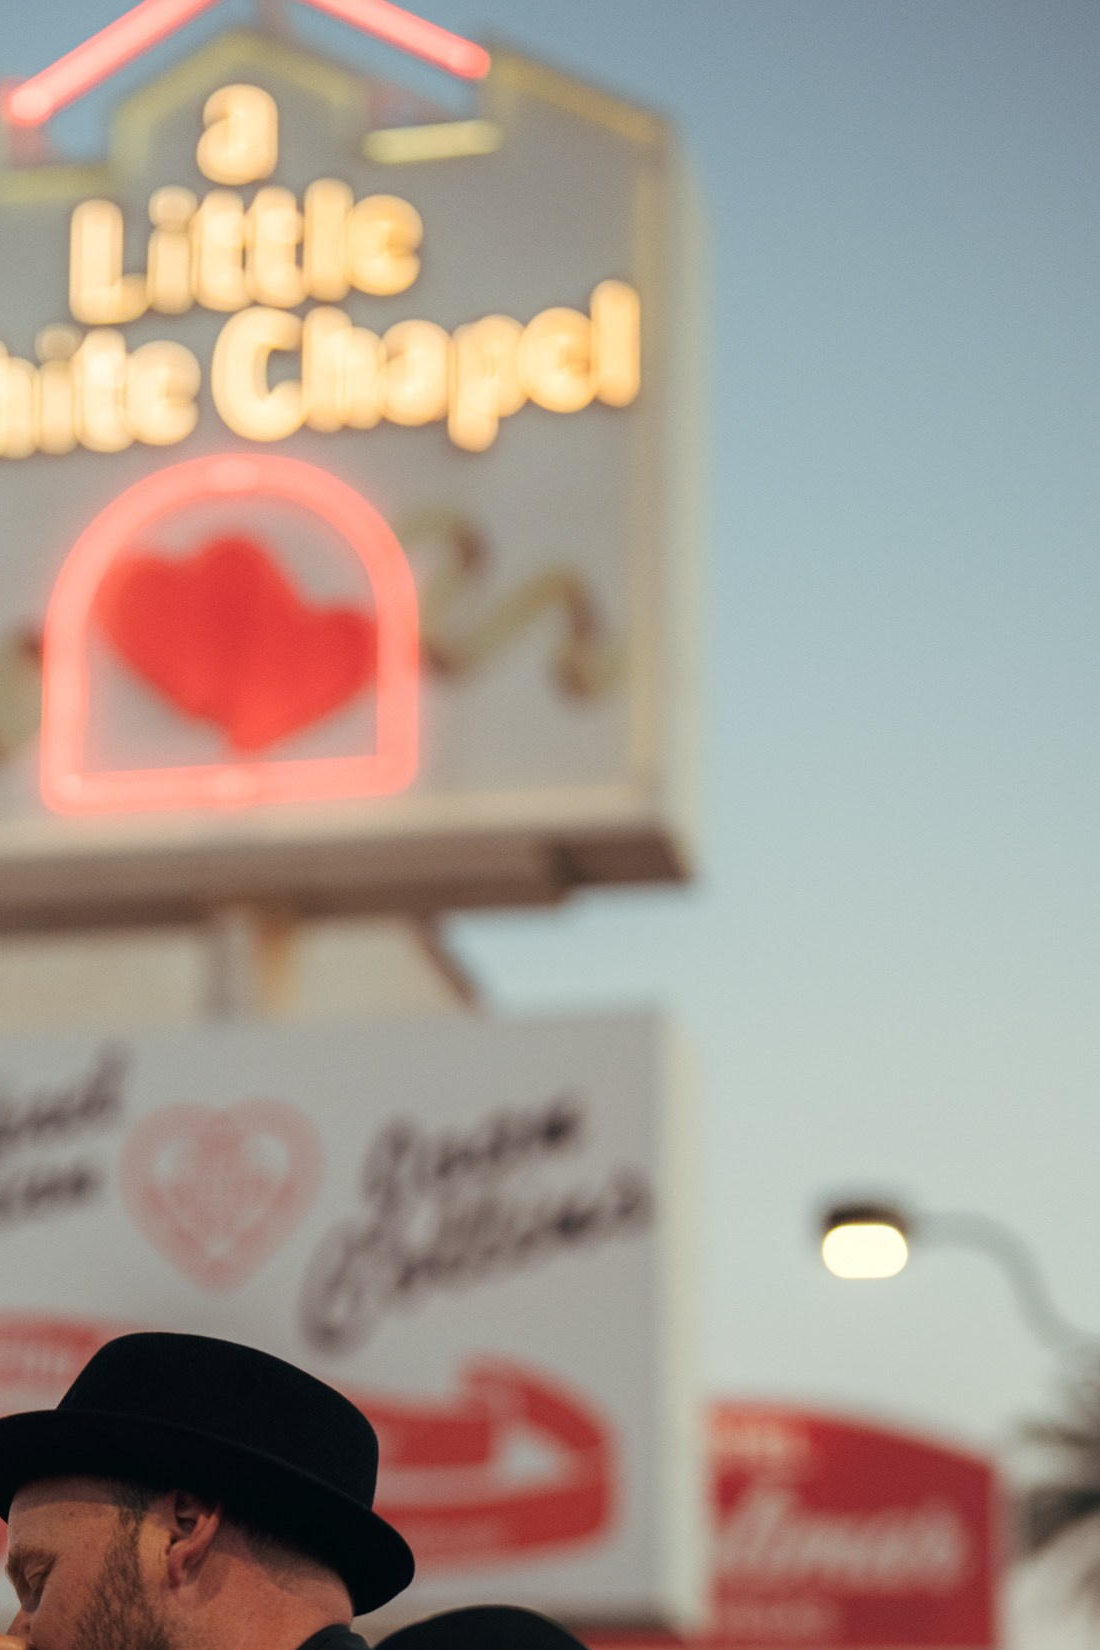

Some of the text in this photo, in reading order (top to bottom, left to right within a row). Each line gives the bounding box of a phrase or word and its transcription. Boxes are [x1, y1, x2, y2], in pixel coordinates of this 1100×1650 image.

[198, 84, 278, 185] a
[69, 178, 423, 325] Little
[211, 280, 641, 453] Chapel
